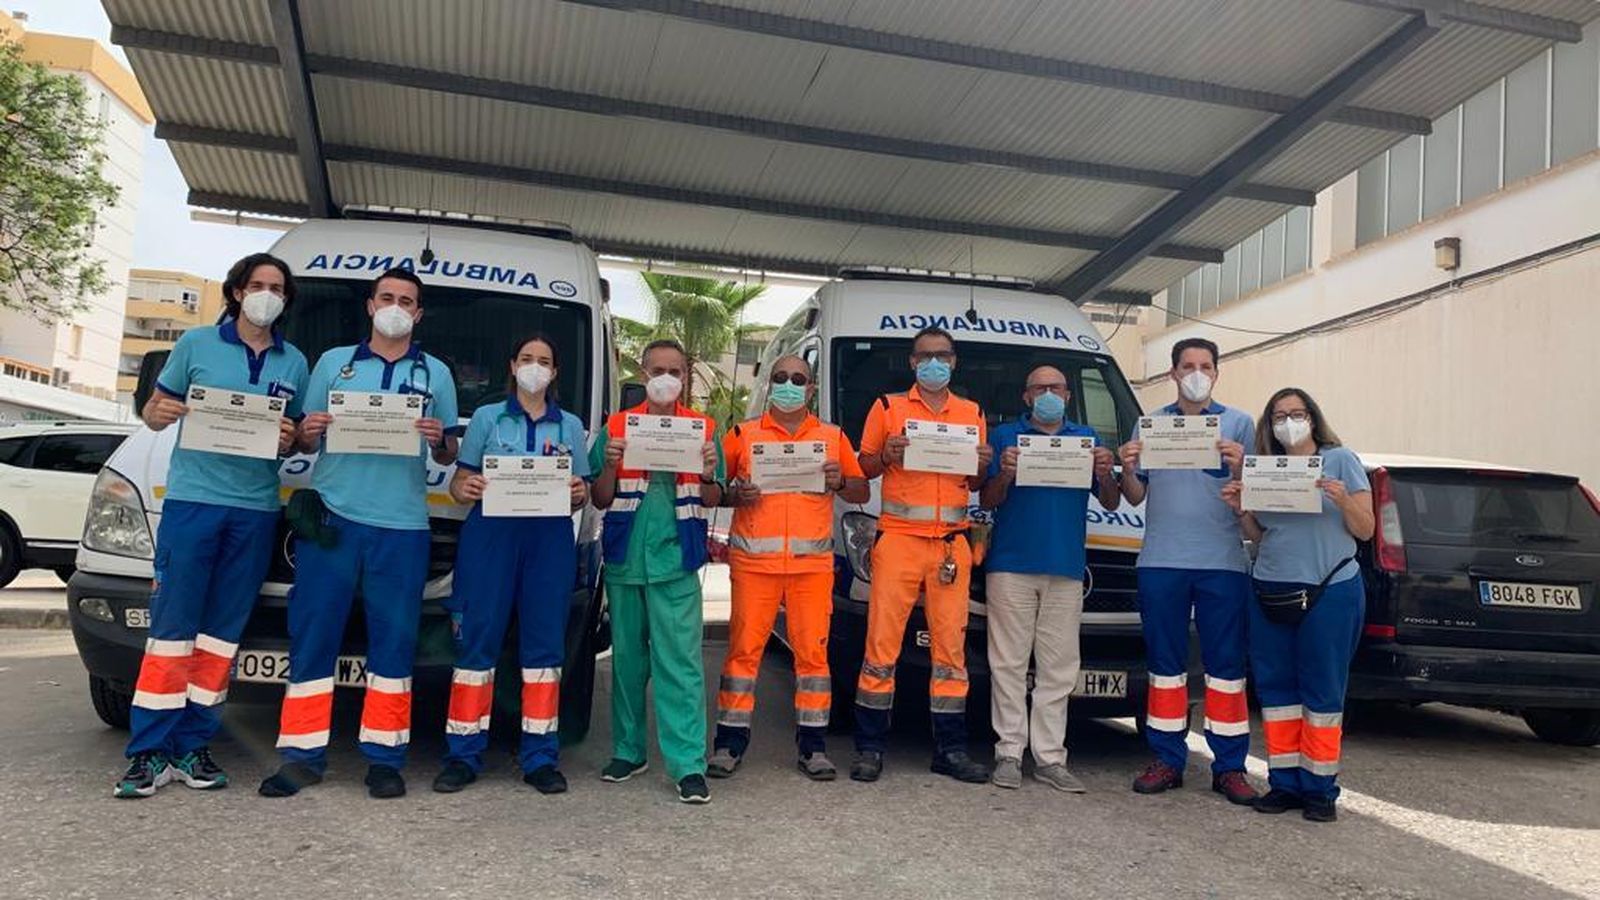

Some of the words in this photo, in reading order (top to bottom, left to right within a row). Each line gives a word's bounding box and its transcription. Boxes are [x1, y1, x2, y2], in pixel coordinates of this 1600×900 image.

[1491, 585, 1536, 604] 8048
[1542, 588, 1576, 607] FGK
[1404, 617, 1438, 625] FOCUS
[243, 654, 291, 679] 092
[338, 659, 368, 684] WX
[1084, 674, 1122, 695] HWX
